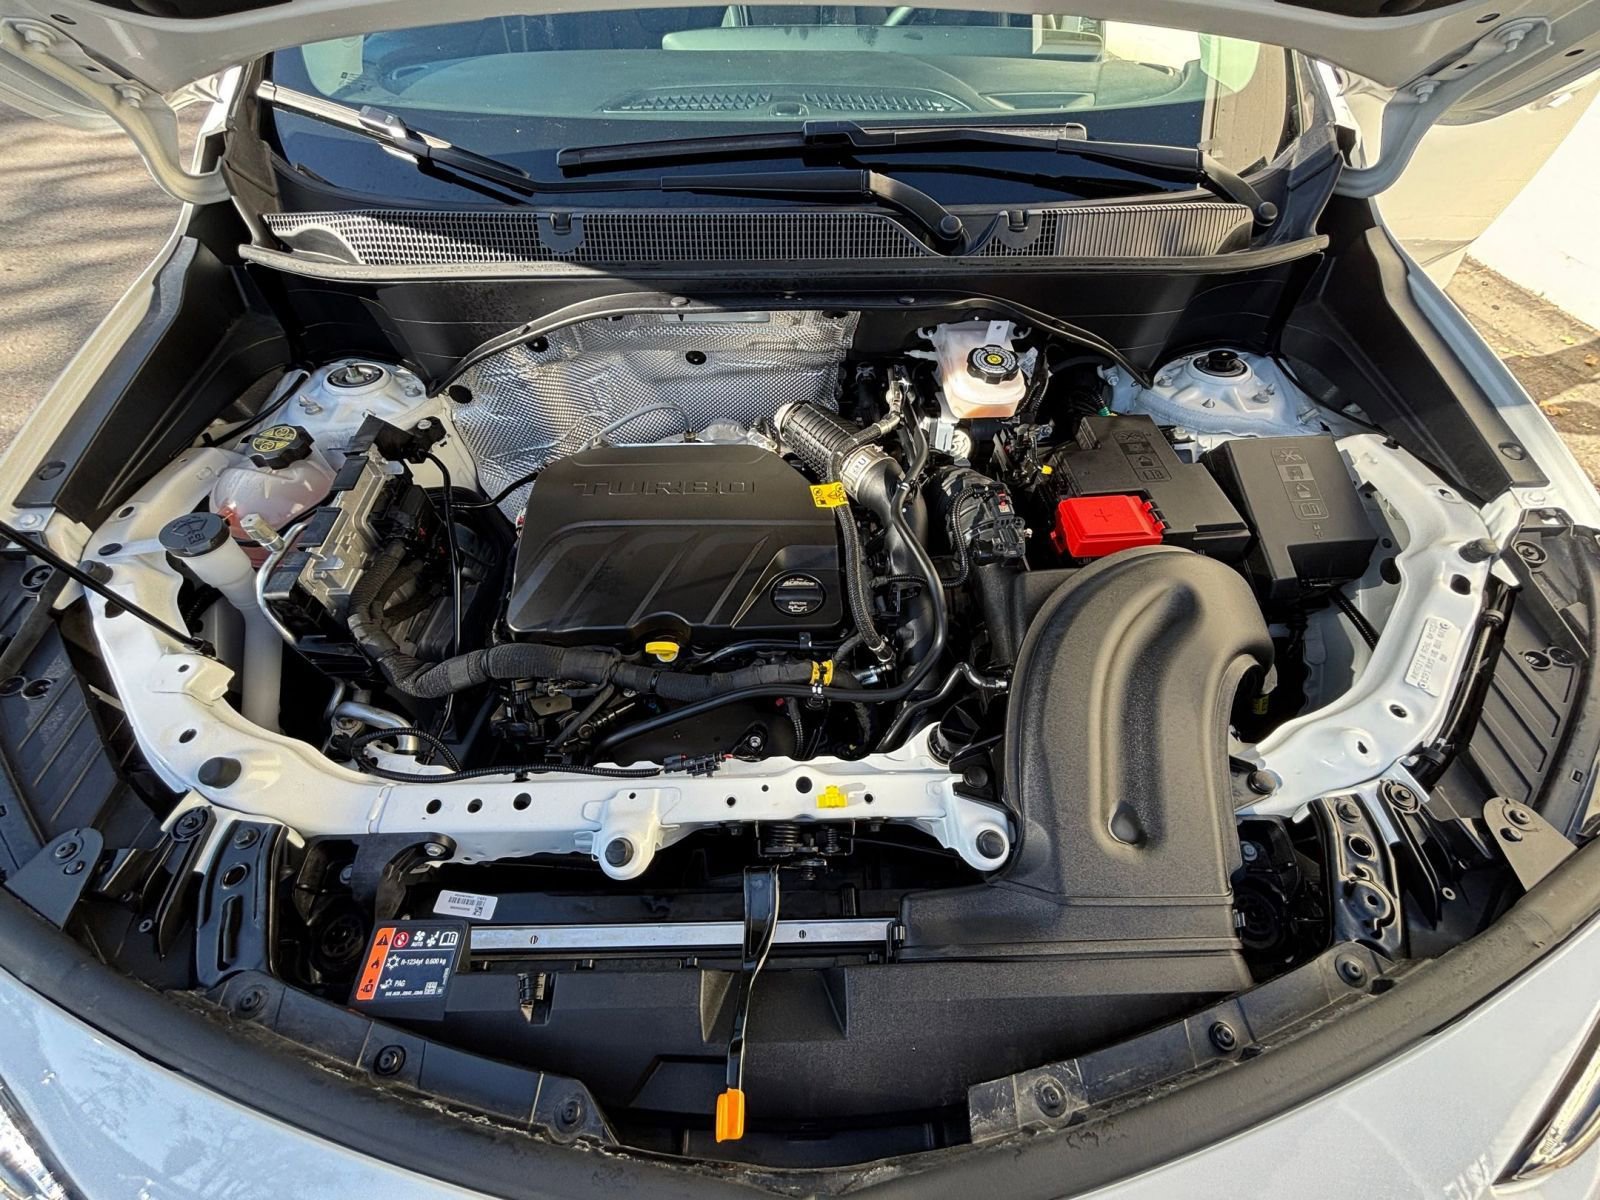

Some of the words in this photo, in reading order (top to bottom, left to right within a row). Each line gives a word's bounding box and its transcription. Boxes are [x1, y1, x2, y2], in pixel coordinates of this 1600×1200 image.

[572, 480, 755, 497] TURBO
[400, 958, 424, 966] R-1234yf
[440, 958, 447, 966] kg
[394, 979, 406, 987] PAG
